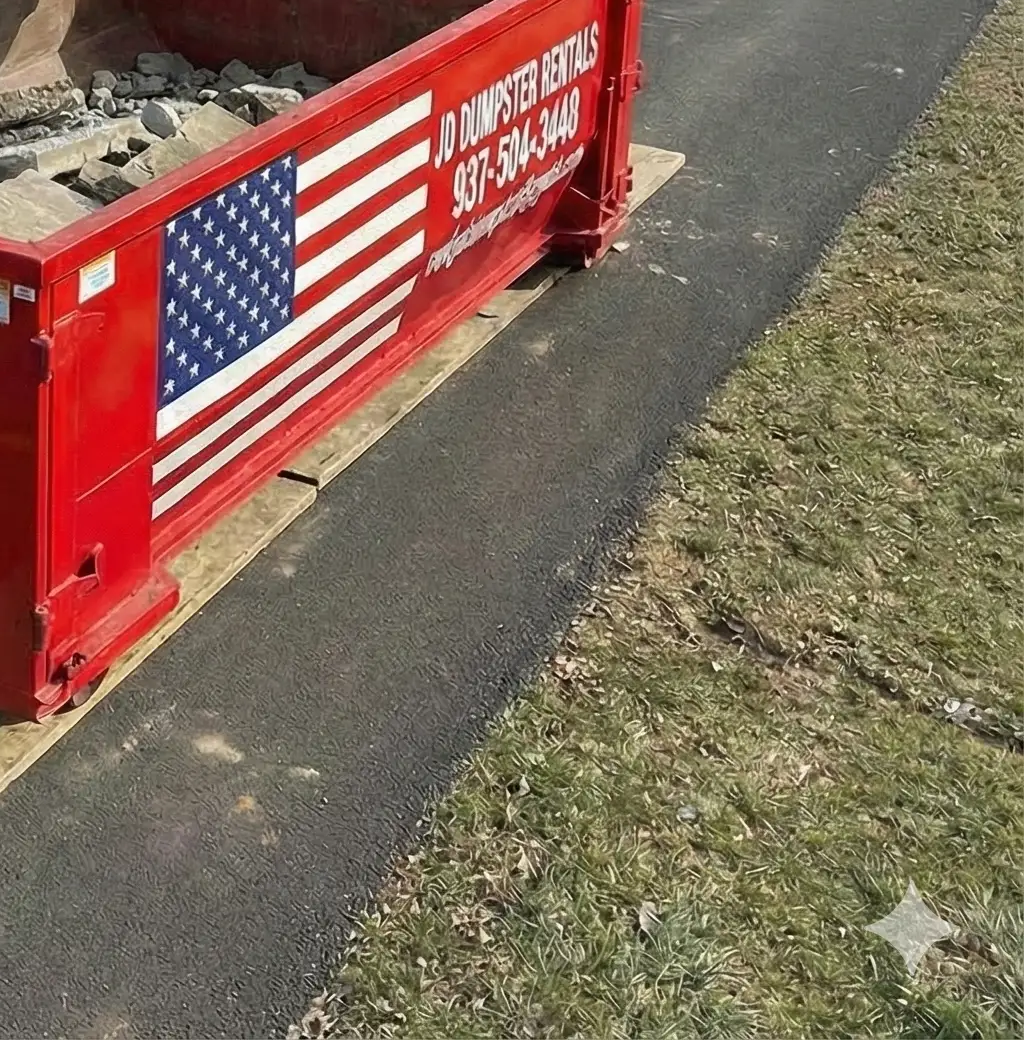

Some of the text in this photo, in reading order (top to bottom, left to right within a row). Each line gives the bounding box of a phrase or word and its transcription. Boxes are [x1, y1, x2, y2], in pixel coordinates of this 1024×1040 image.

[434, 19, 600, 170] JD DUMPSTER RENTALS
[451, 85, 581, 220] 937-504-3448
